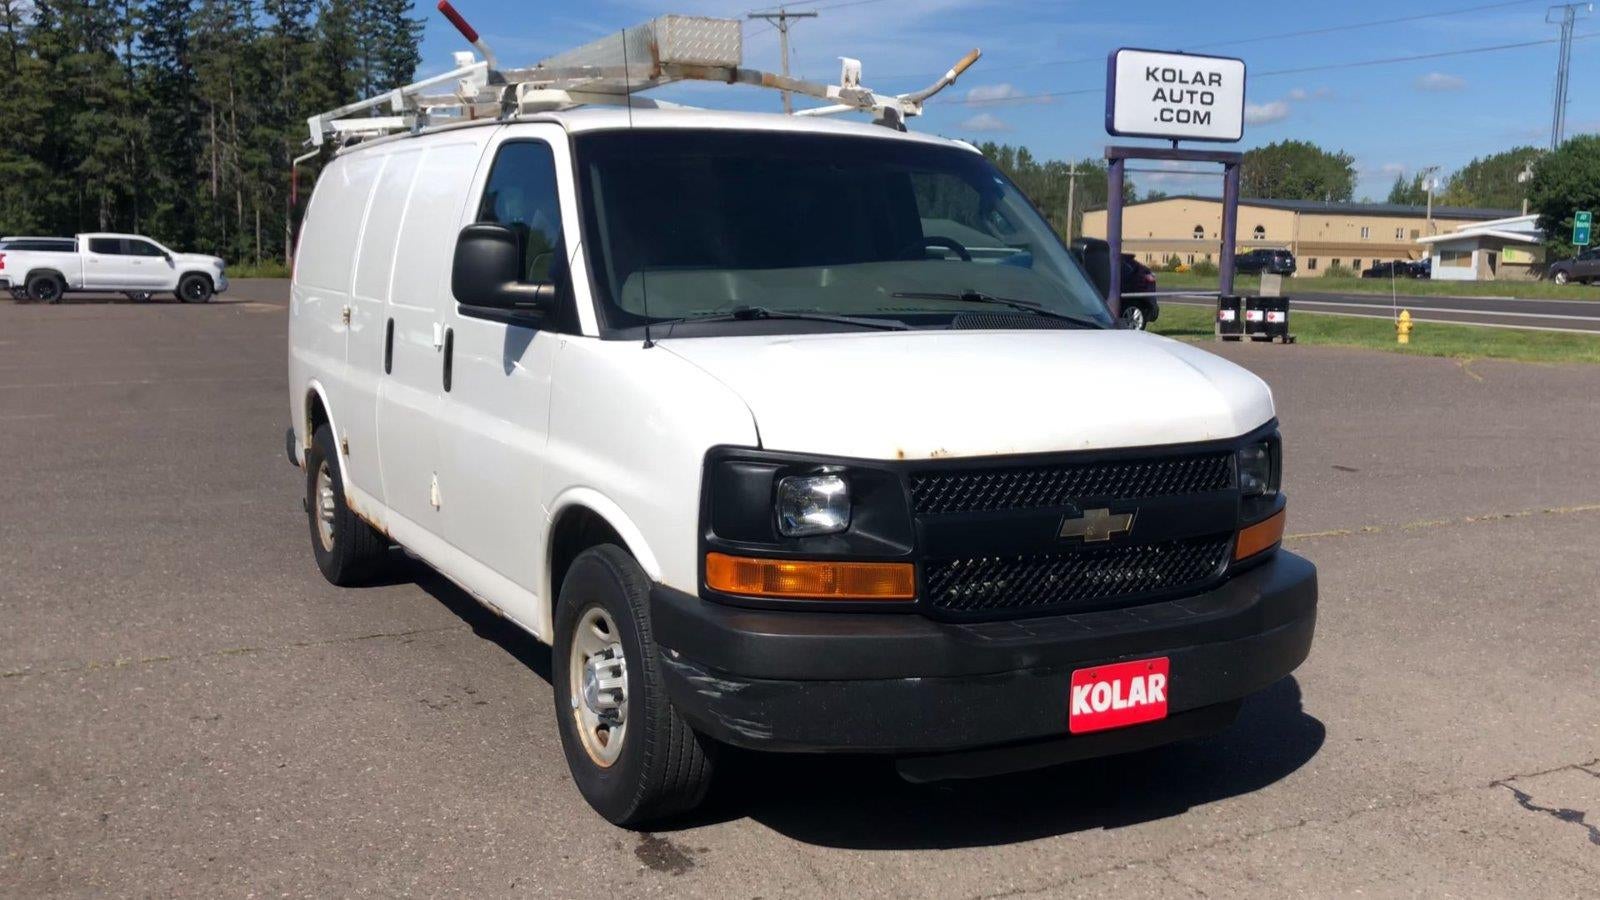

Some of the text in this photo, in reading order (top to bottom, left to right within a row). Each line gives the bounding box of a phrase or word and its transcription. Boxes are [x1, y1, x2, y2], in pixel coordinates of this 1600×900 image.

[1146, 66, 1222, 87] KOLAR
[1153, 88, 1215, 105] AUTO
[1154, 108, 1211, 125] .COM
[1072, 673, 1166, 716] KOLAR
